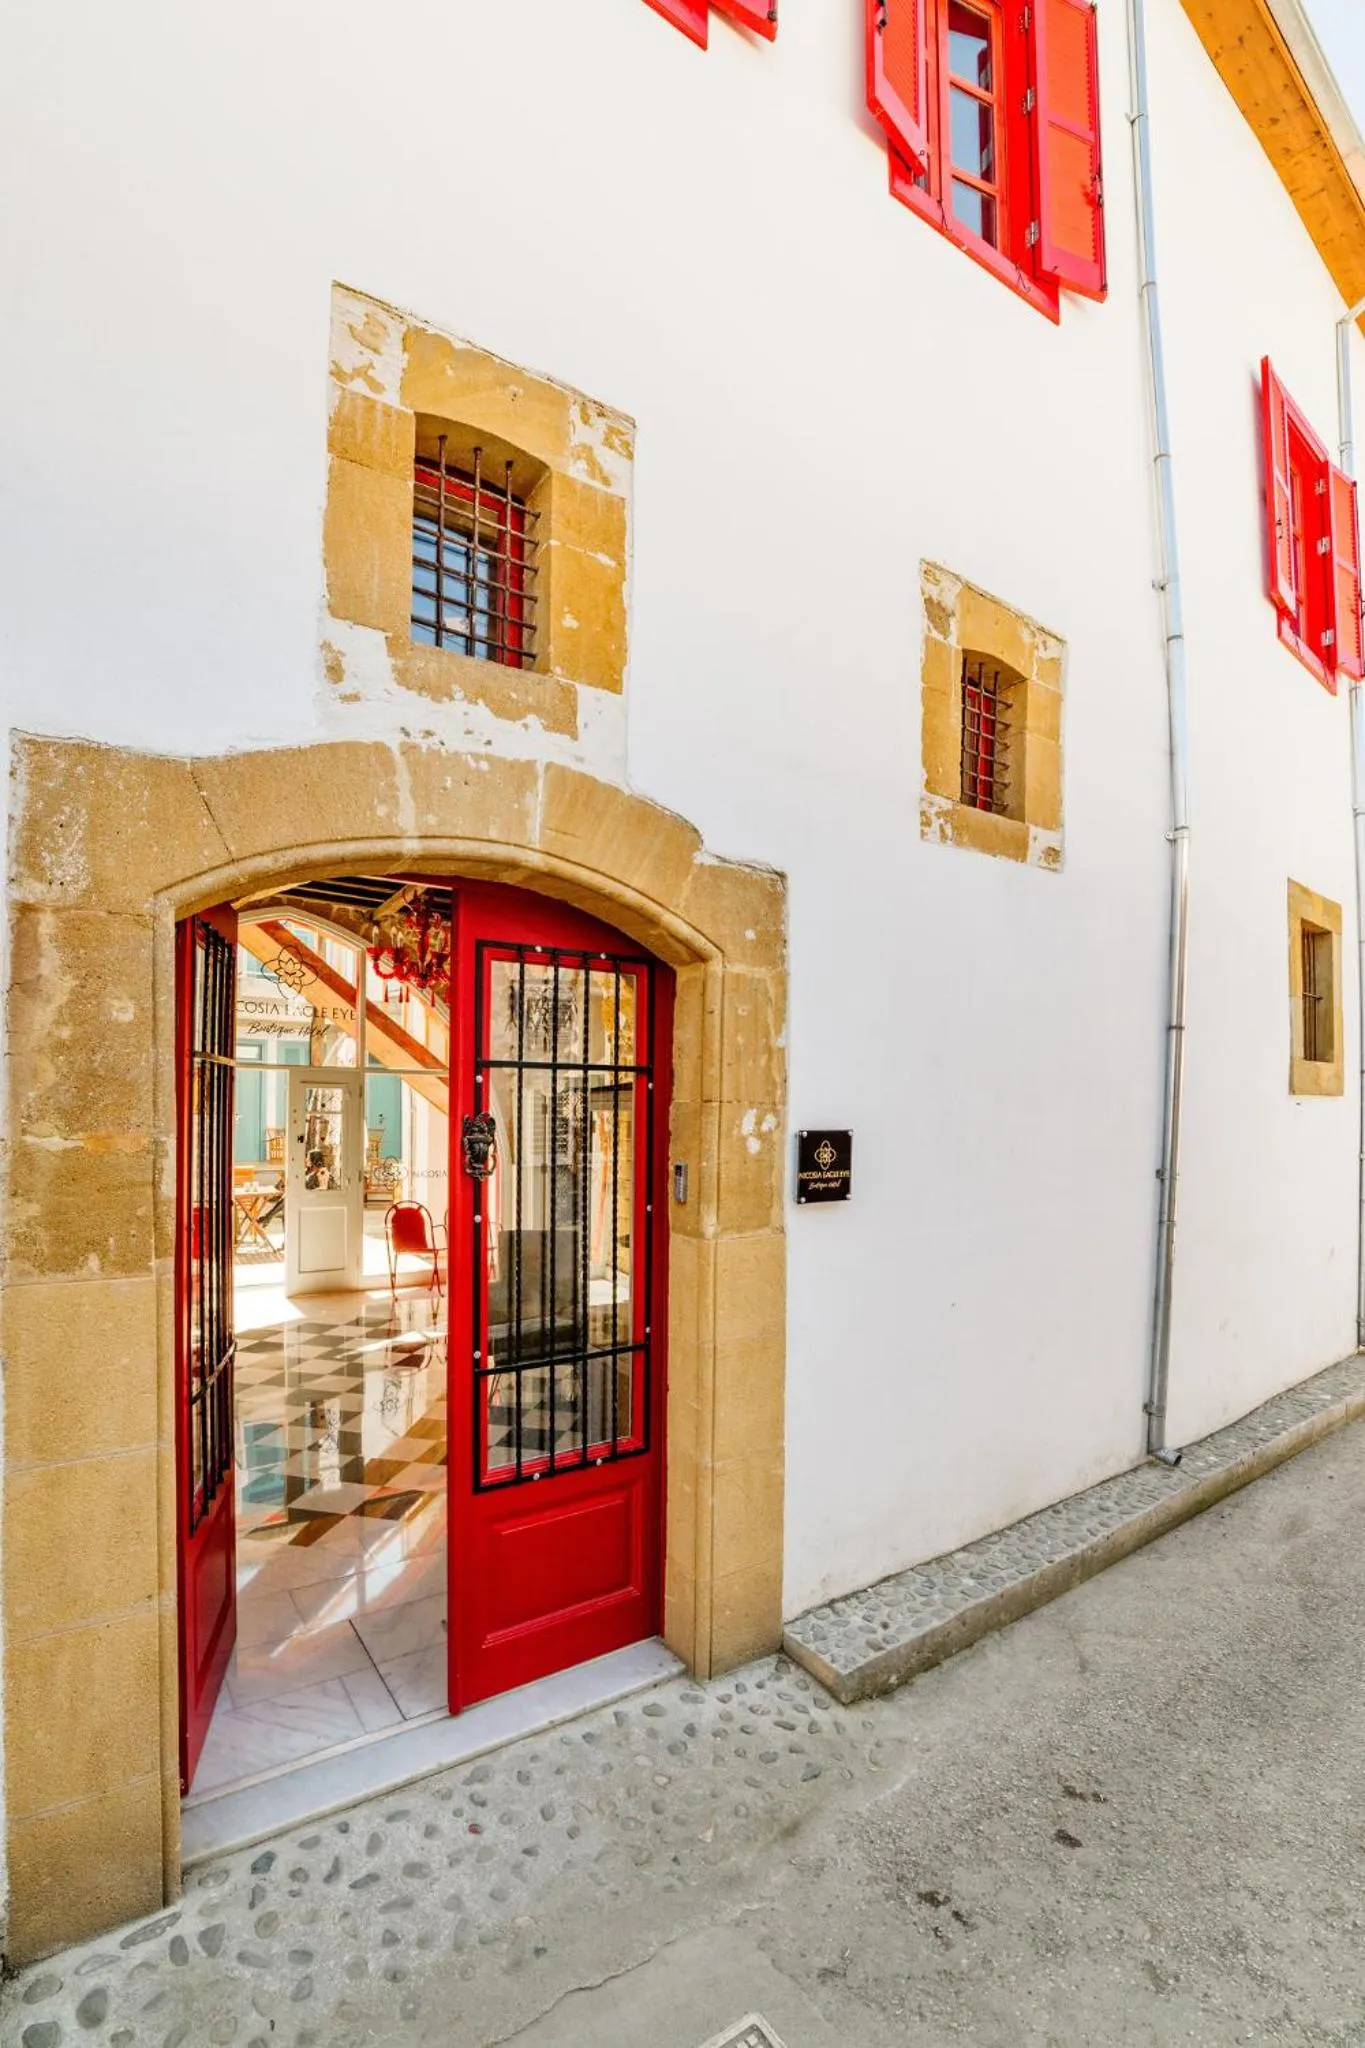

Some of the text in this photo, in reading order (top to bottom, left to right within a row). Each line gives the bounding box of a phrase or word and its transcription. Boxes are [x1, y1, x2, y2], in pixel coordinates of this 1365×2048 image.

[237, 1000, 280, 1015] COSIA
[333, 1007, 358, 1021] EYE
[248, 1020, 331, 1038] Boutique Hotel
